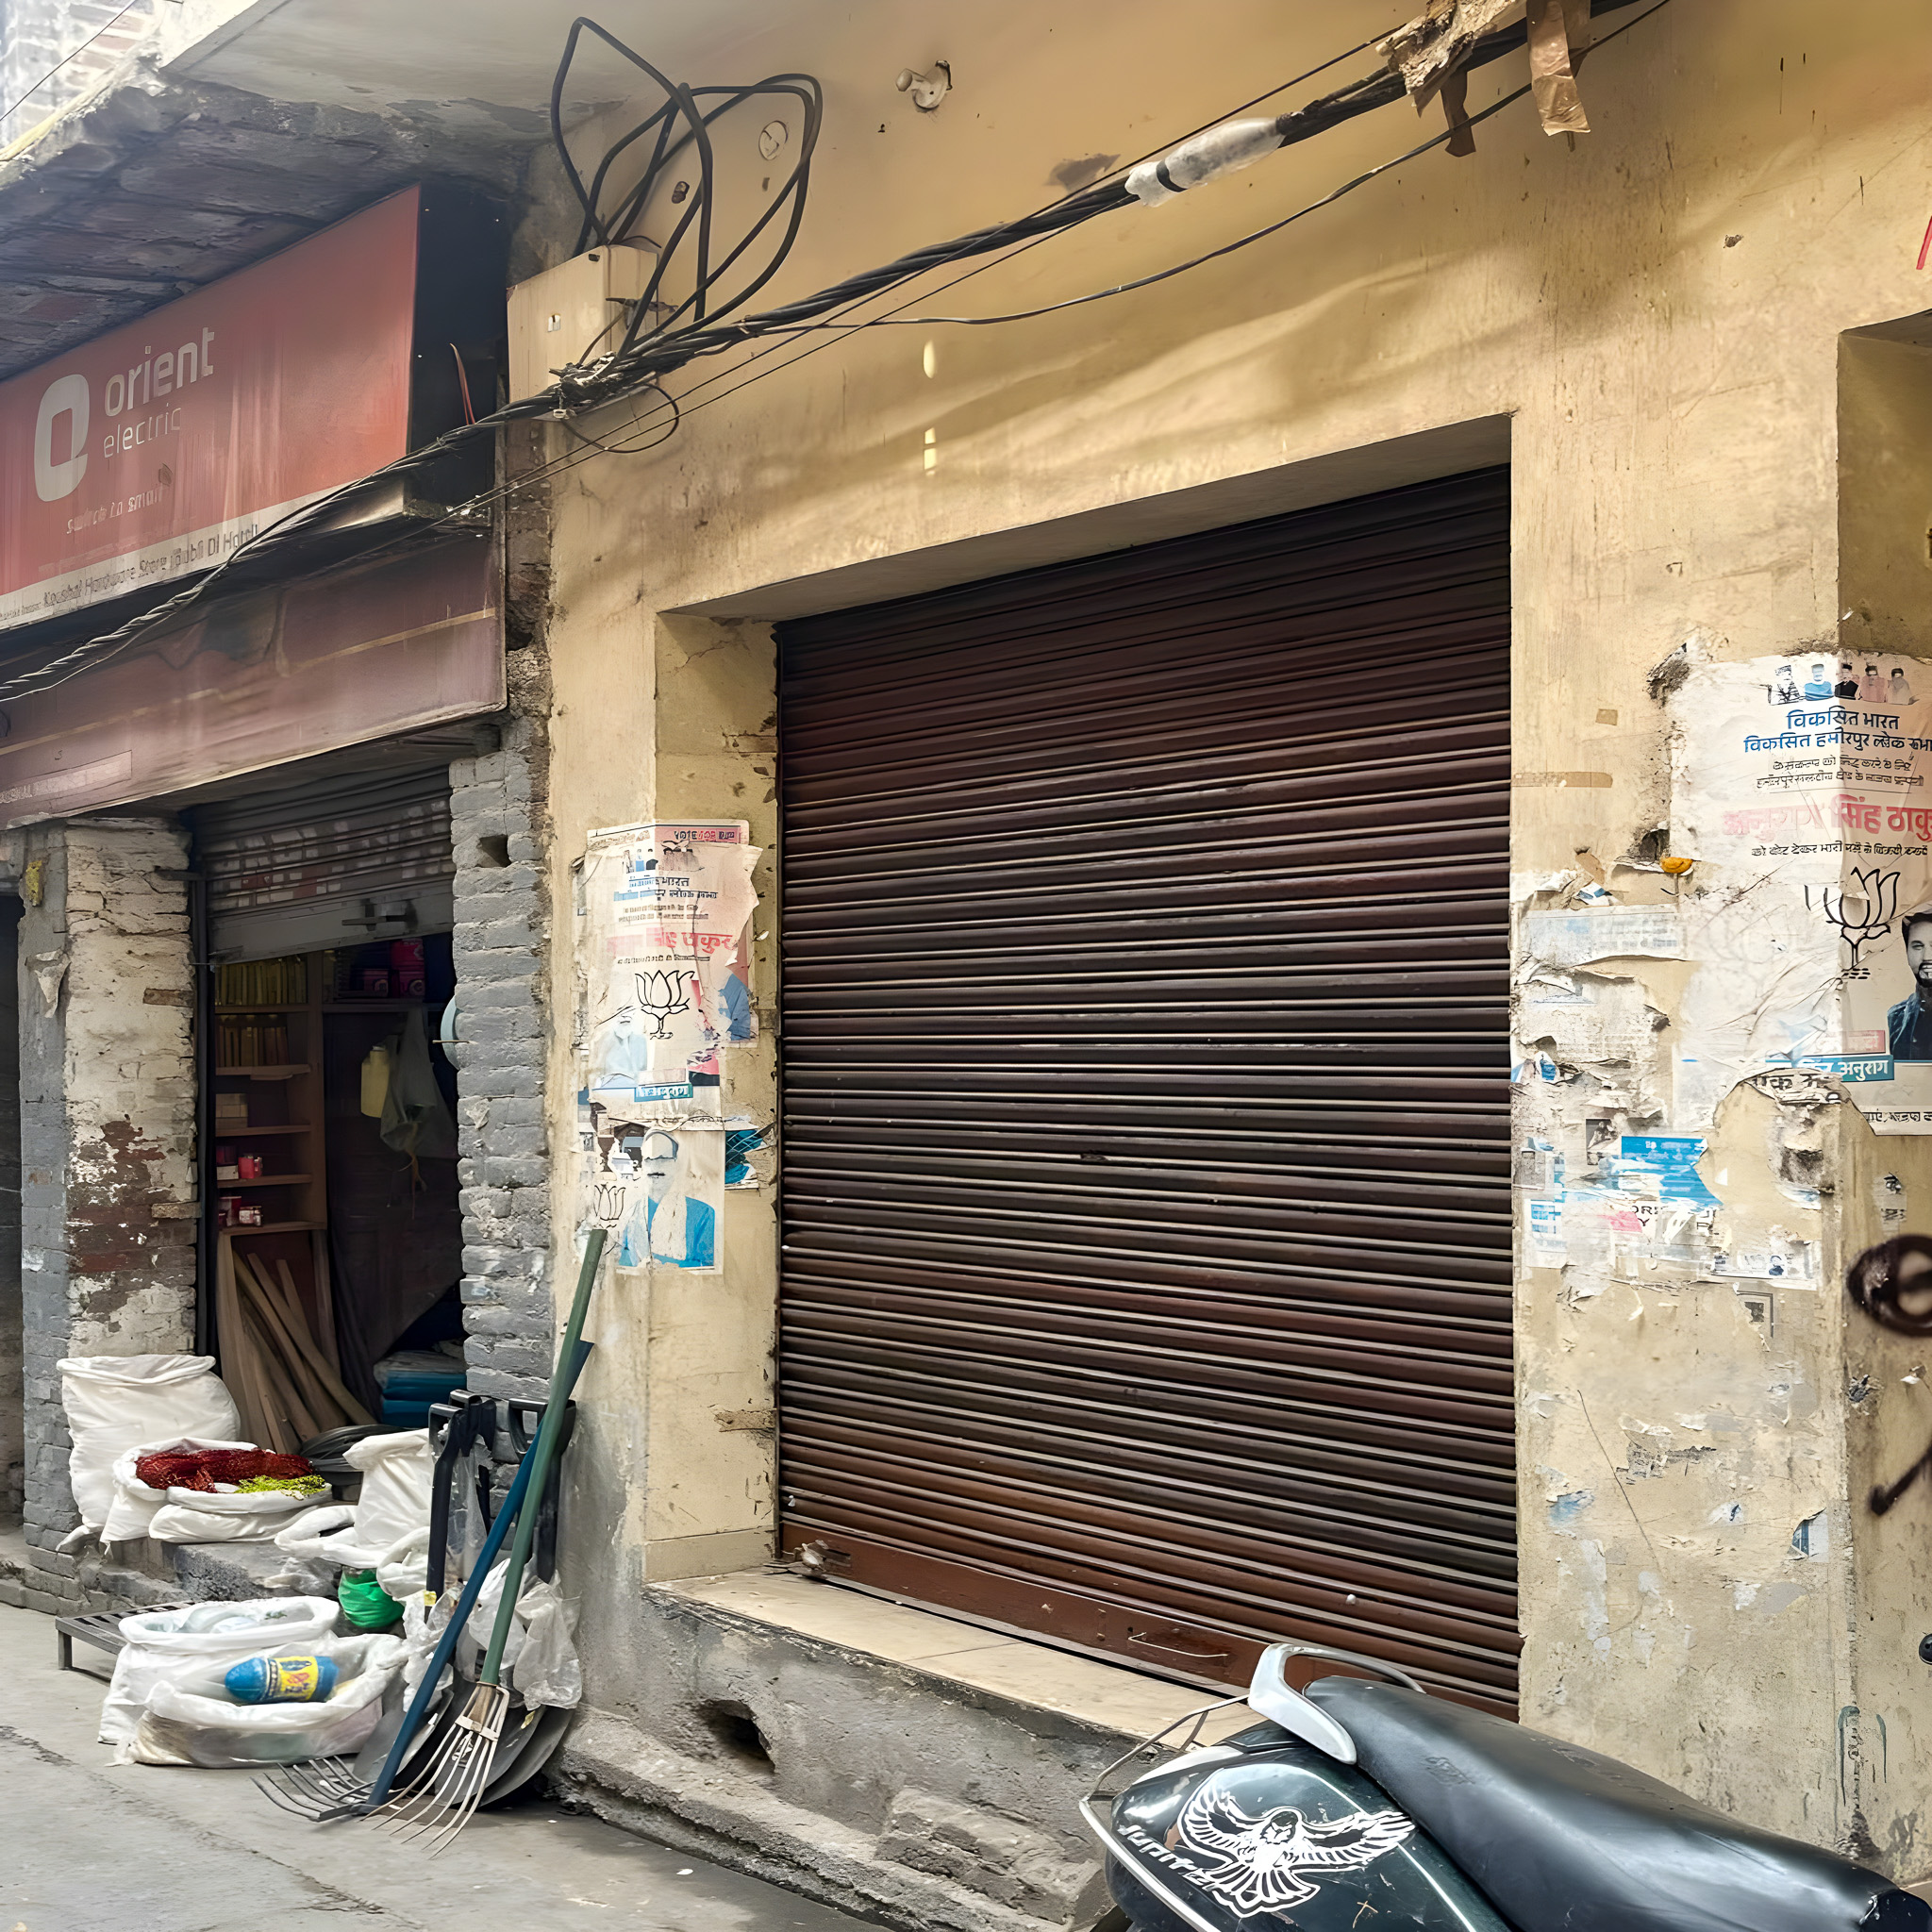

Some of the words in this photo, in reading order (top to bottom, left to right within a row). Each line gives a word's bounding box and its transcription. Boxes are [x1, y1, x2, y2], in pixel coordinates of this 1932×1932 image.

[105, 326, 215, 418] orient
[104, 402, 183, 459] electric
[1786, 706, 1858, 729] विकसित
[1863, 712, 1900, 730] भारत
[1743, 731, 1811, 753] विकसित
[1831, 793, 1882, 834] सिंह
[1886, 806, 1932, 842] ठाकु
[1839, 1059, 1889, 1082] अनुराग
